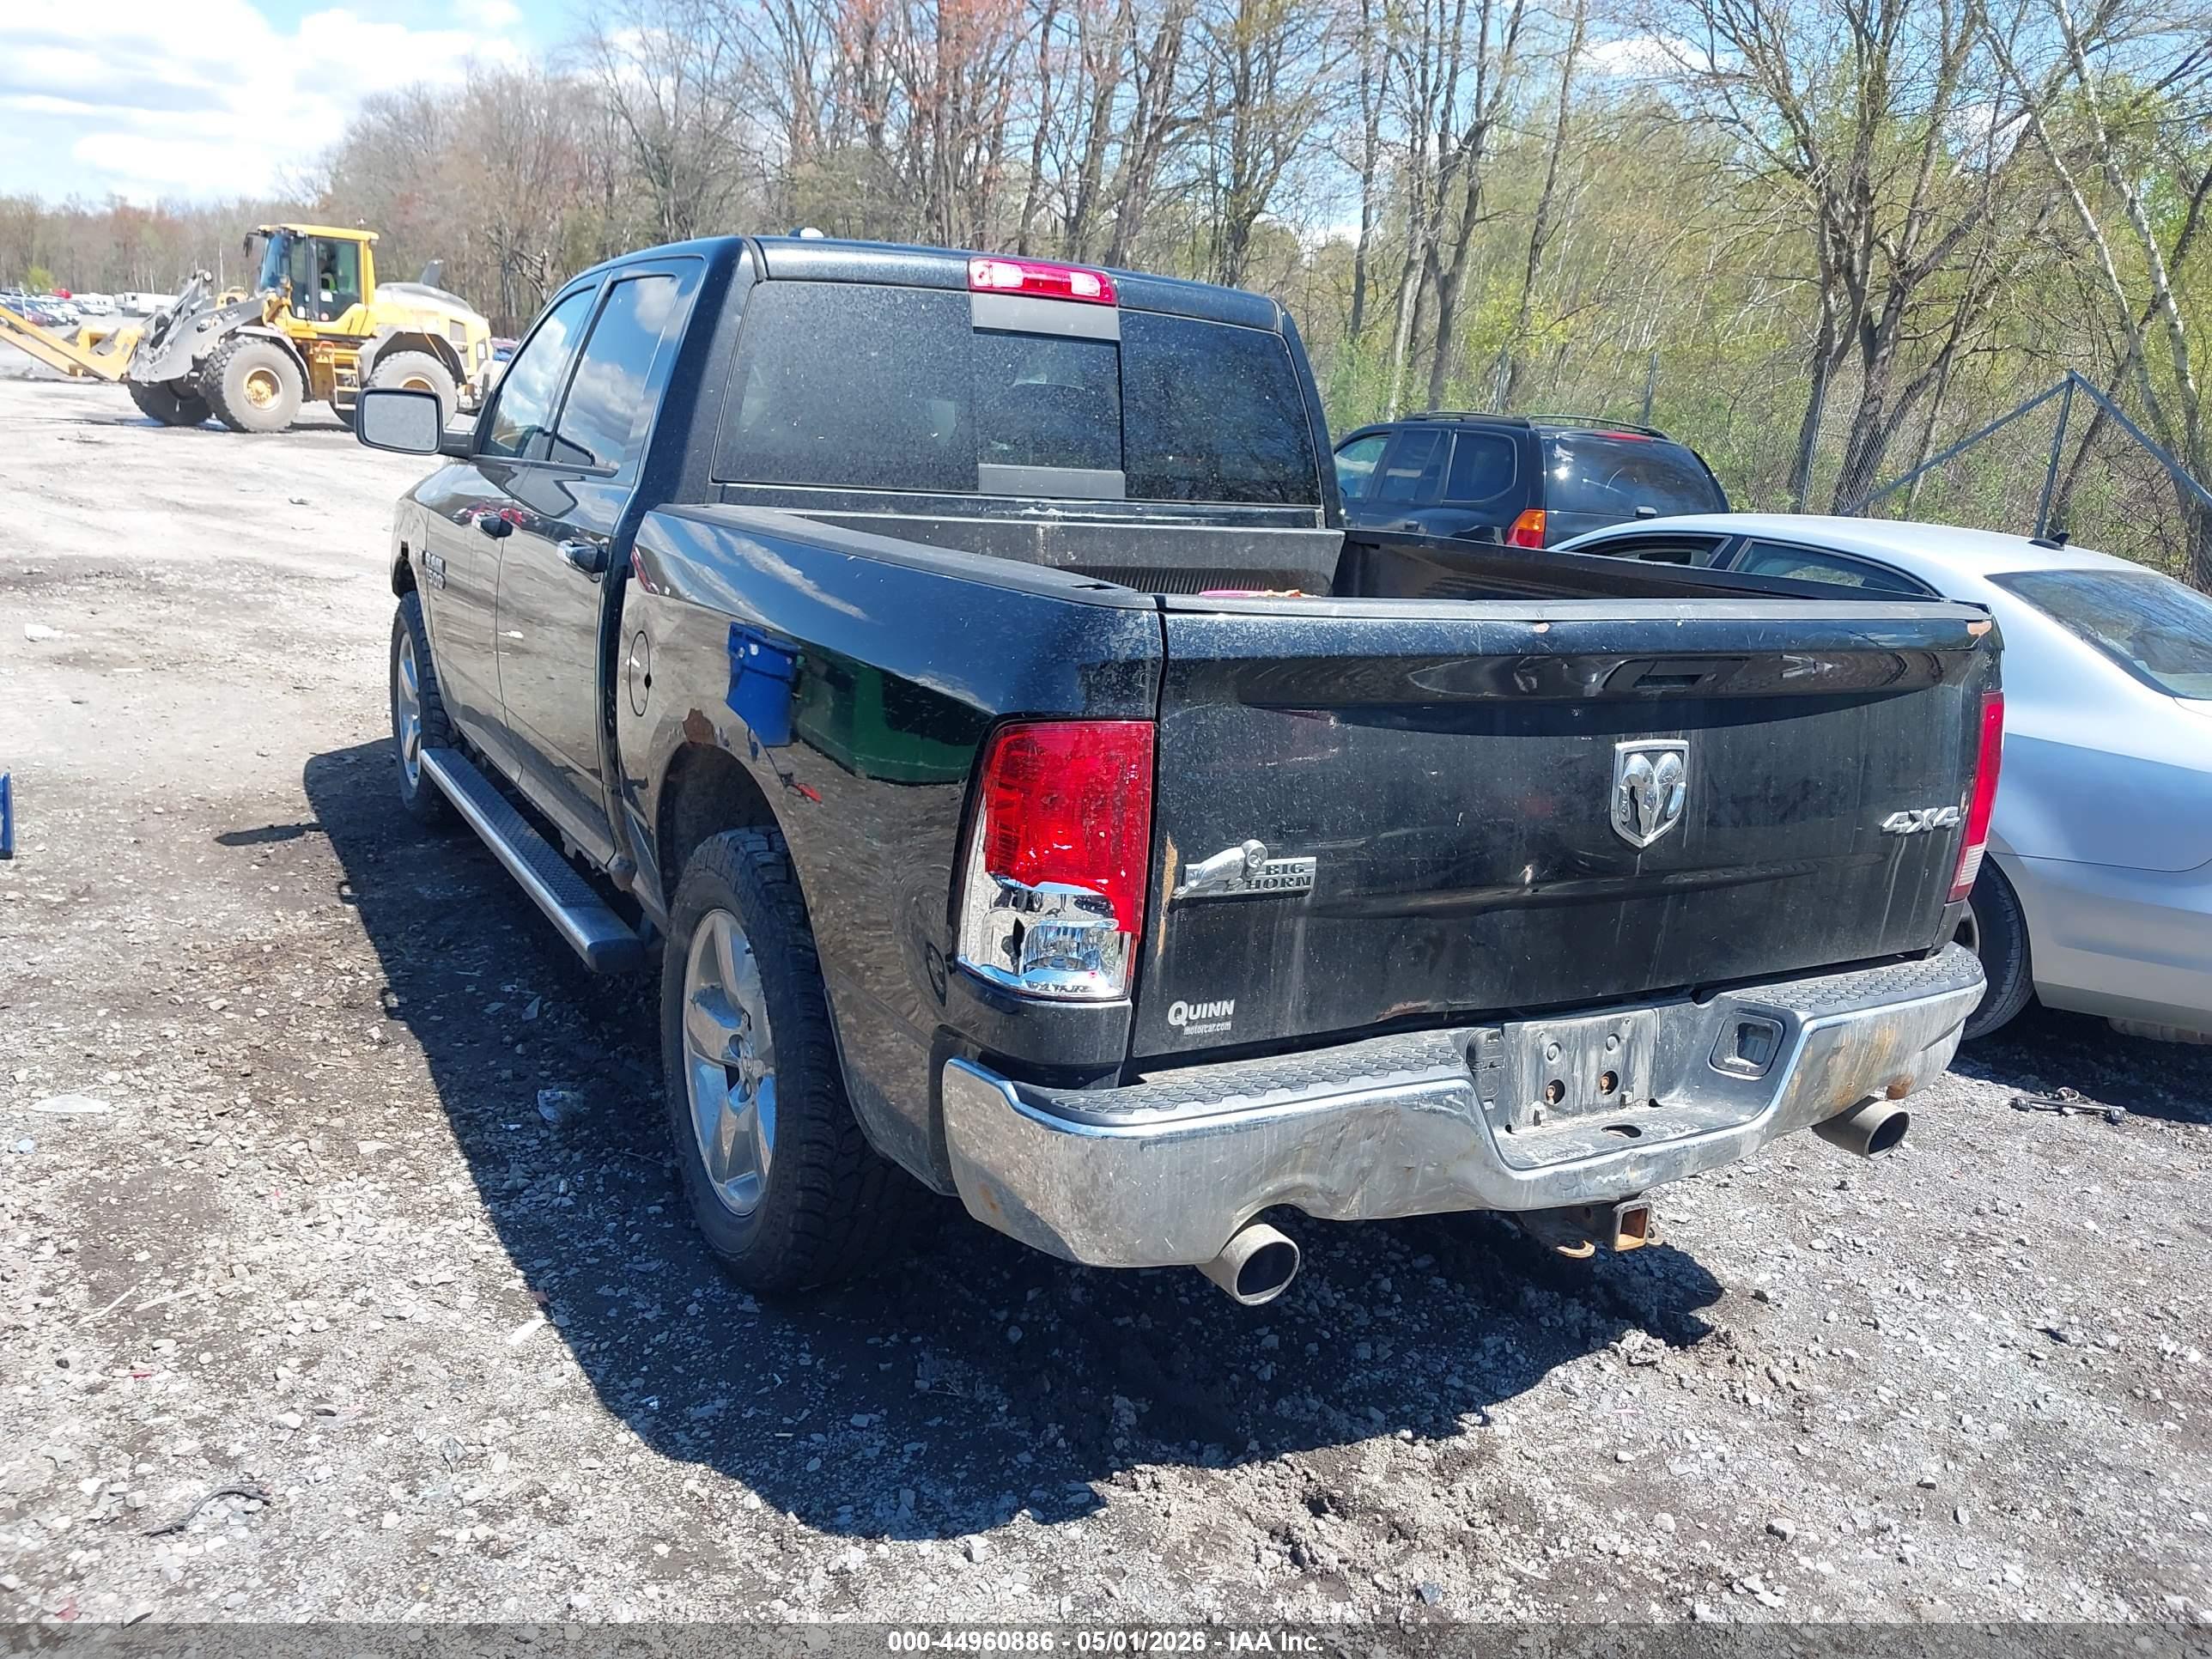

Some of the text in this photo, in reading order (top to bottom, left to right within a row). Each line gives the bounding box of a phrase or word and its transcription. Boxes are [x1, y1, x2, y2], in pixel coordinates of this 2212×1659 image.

[424, 551, 444, 573] RAM
[1266, 862, 1305, 876] BIG
[1245, 876, 1312, 890] HORN
